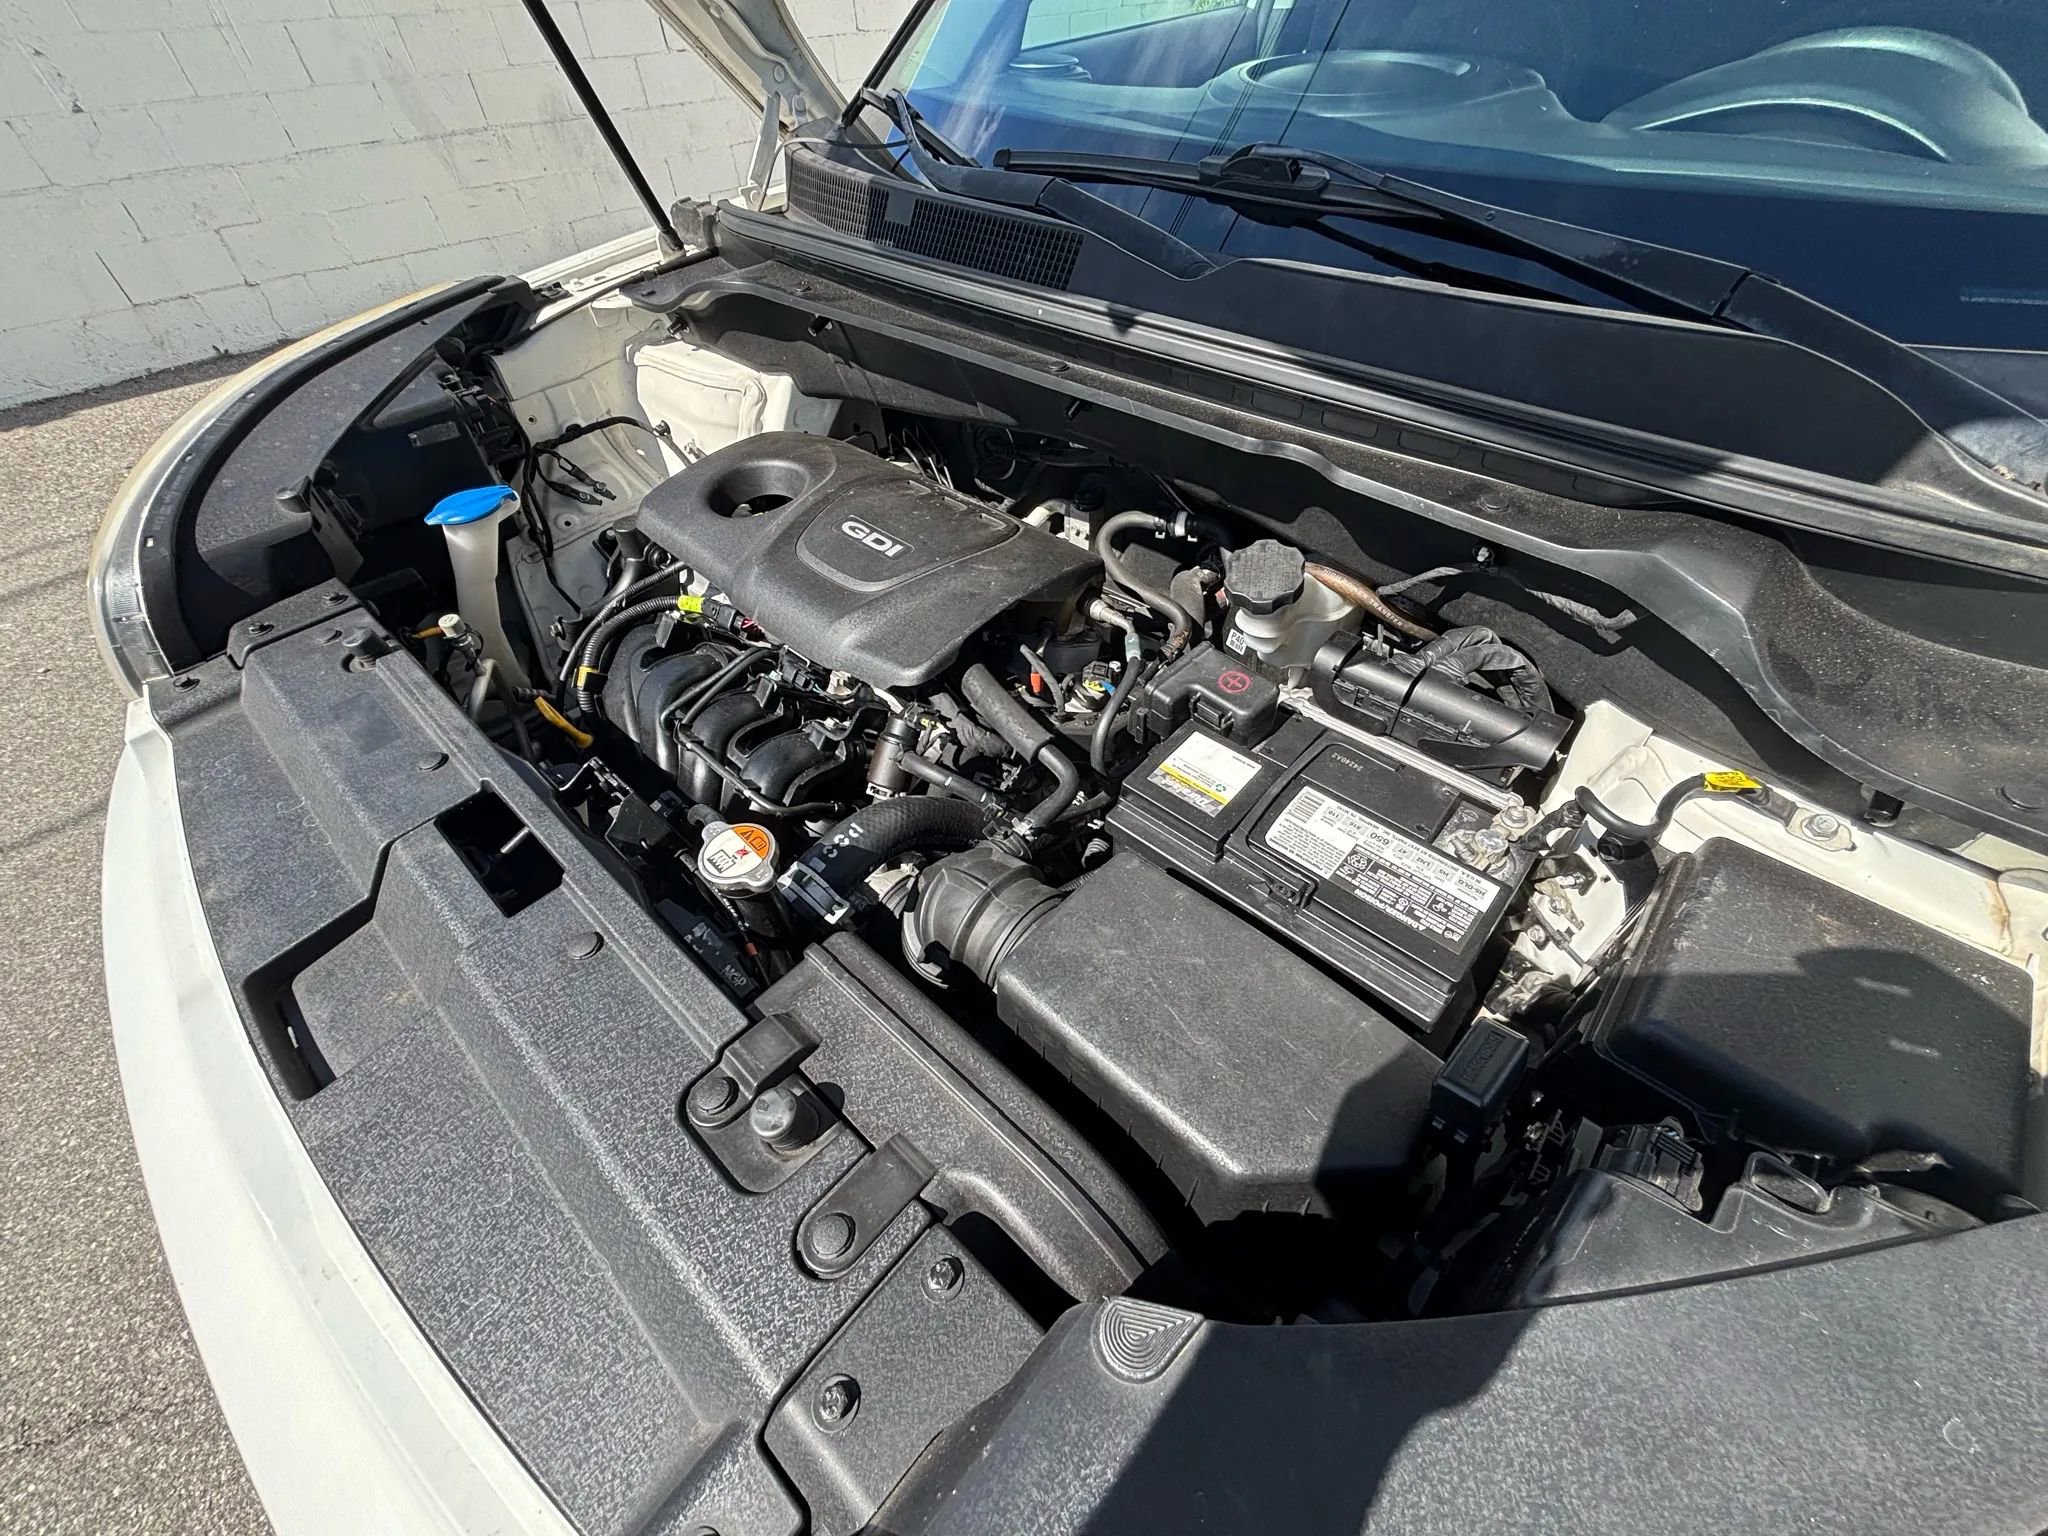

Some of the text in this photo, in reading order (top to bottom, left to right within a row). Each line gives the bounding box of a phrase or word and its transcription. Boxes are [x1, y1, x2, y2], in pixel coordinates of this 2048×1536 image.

[841, 521, 904, 557] GDI
[1368, 598, 1403, 627] TRANSFER
[1368, 830, 1391, 847] 650
